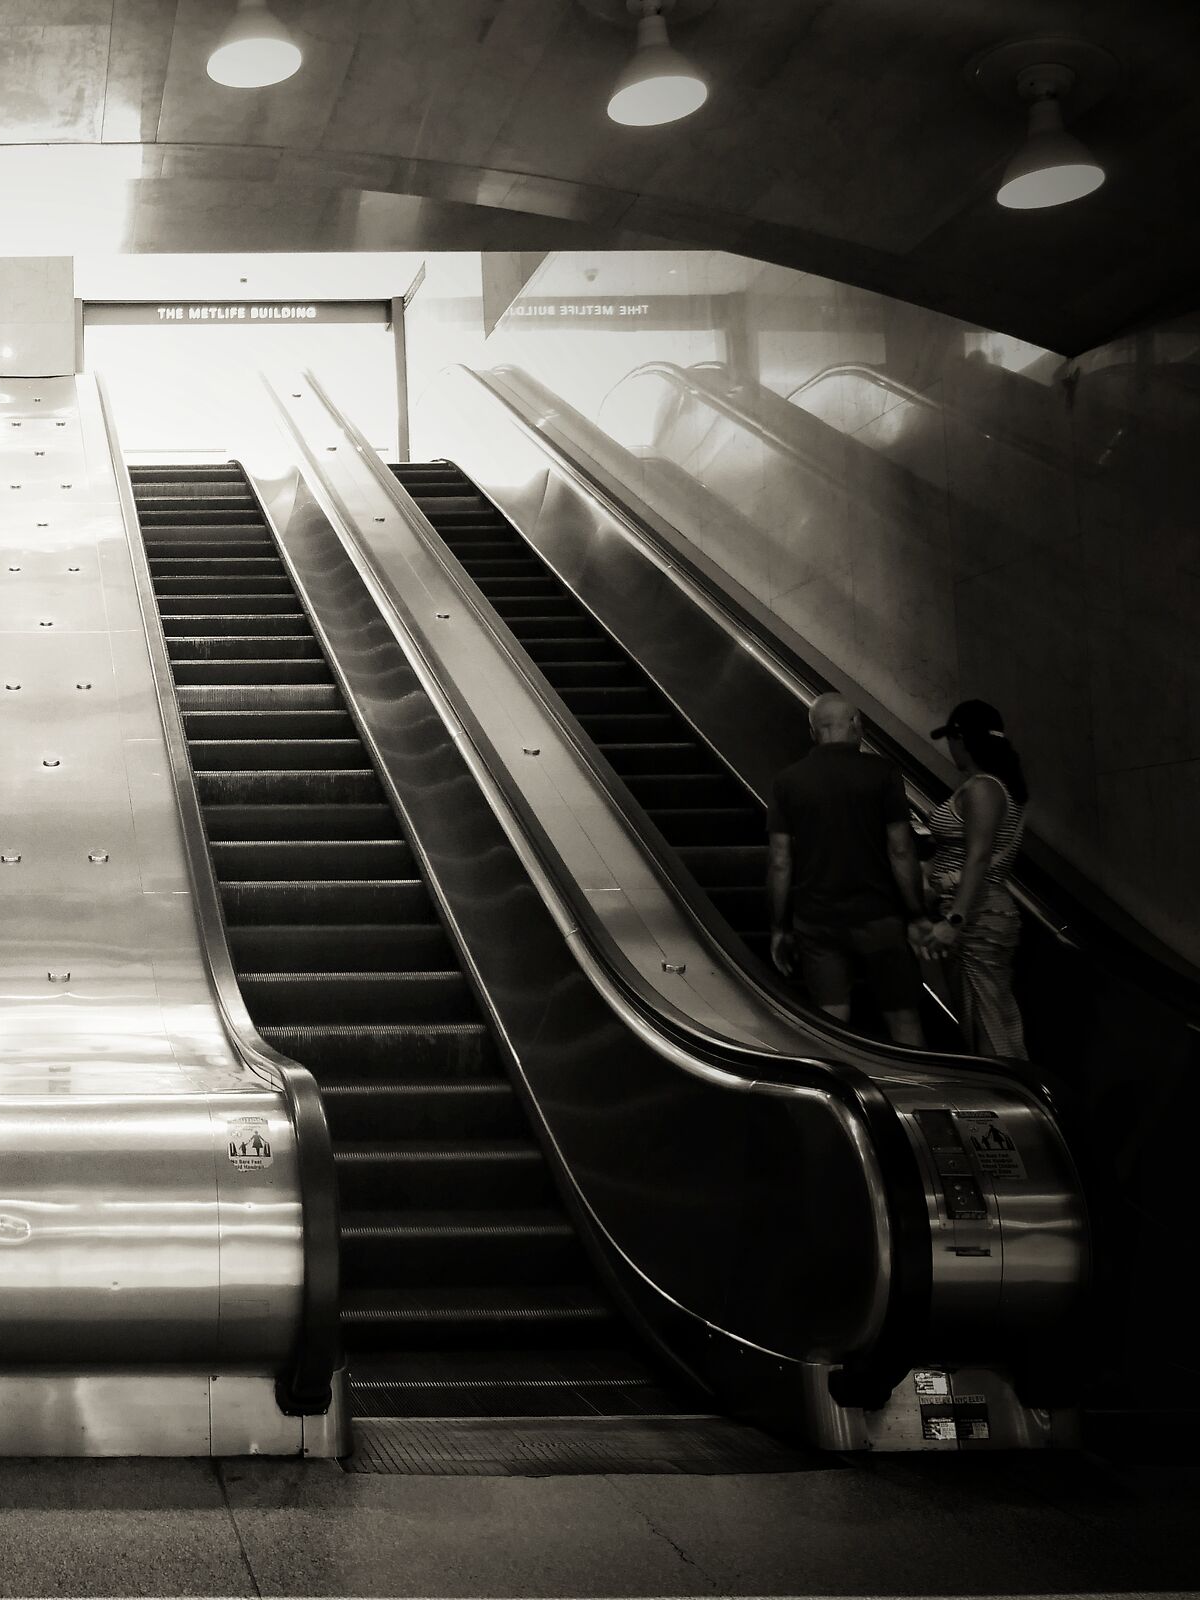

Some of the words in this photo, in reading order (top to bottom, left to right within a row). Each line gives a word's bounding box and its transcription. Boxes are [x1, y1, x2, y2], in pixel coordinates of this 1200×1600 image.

[157, 308, 183, 320] THE
[188, 307, 246, 319] METLIFE
[250, 306, 317, 319] BUILDING
